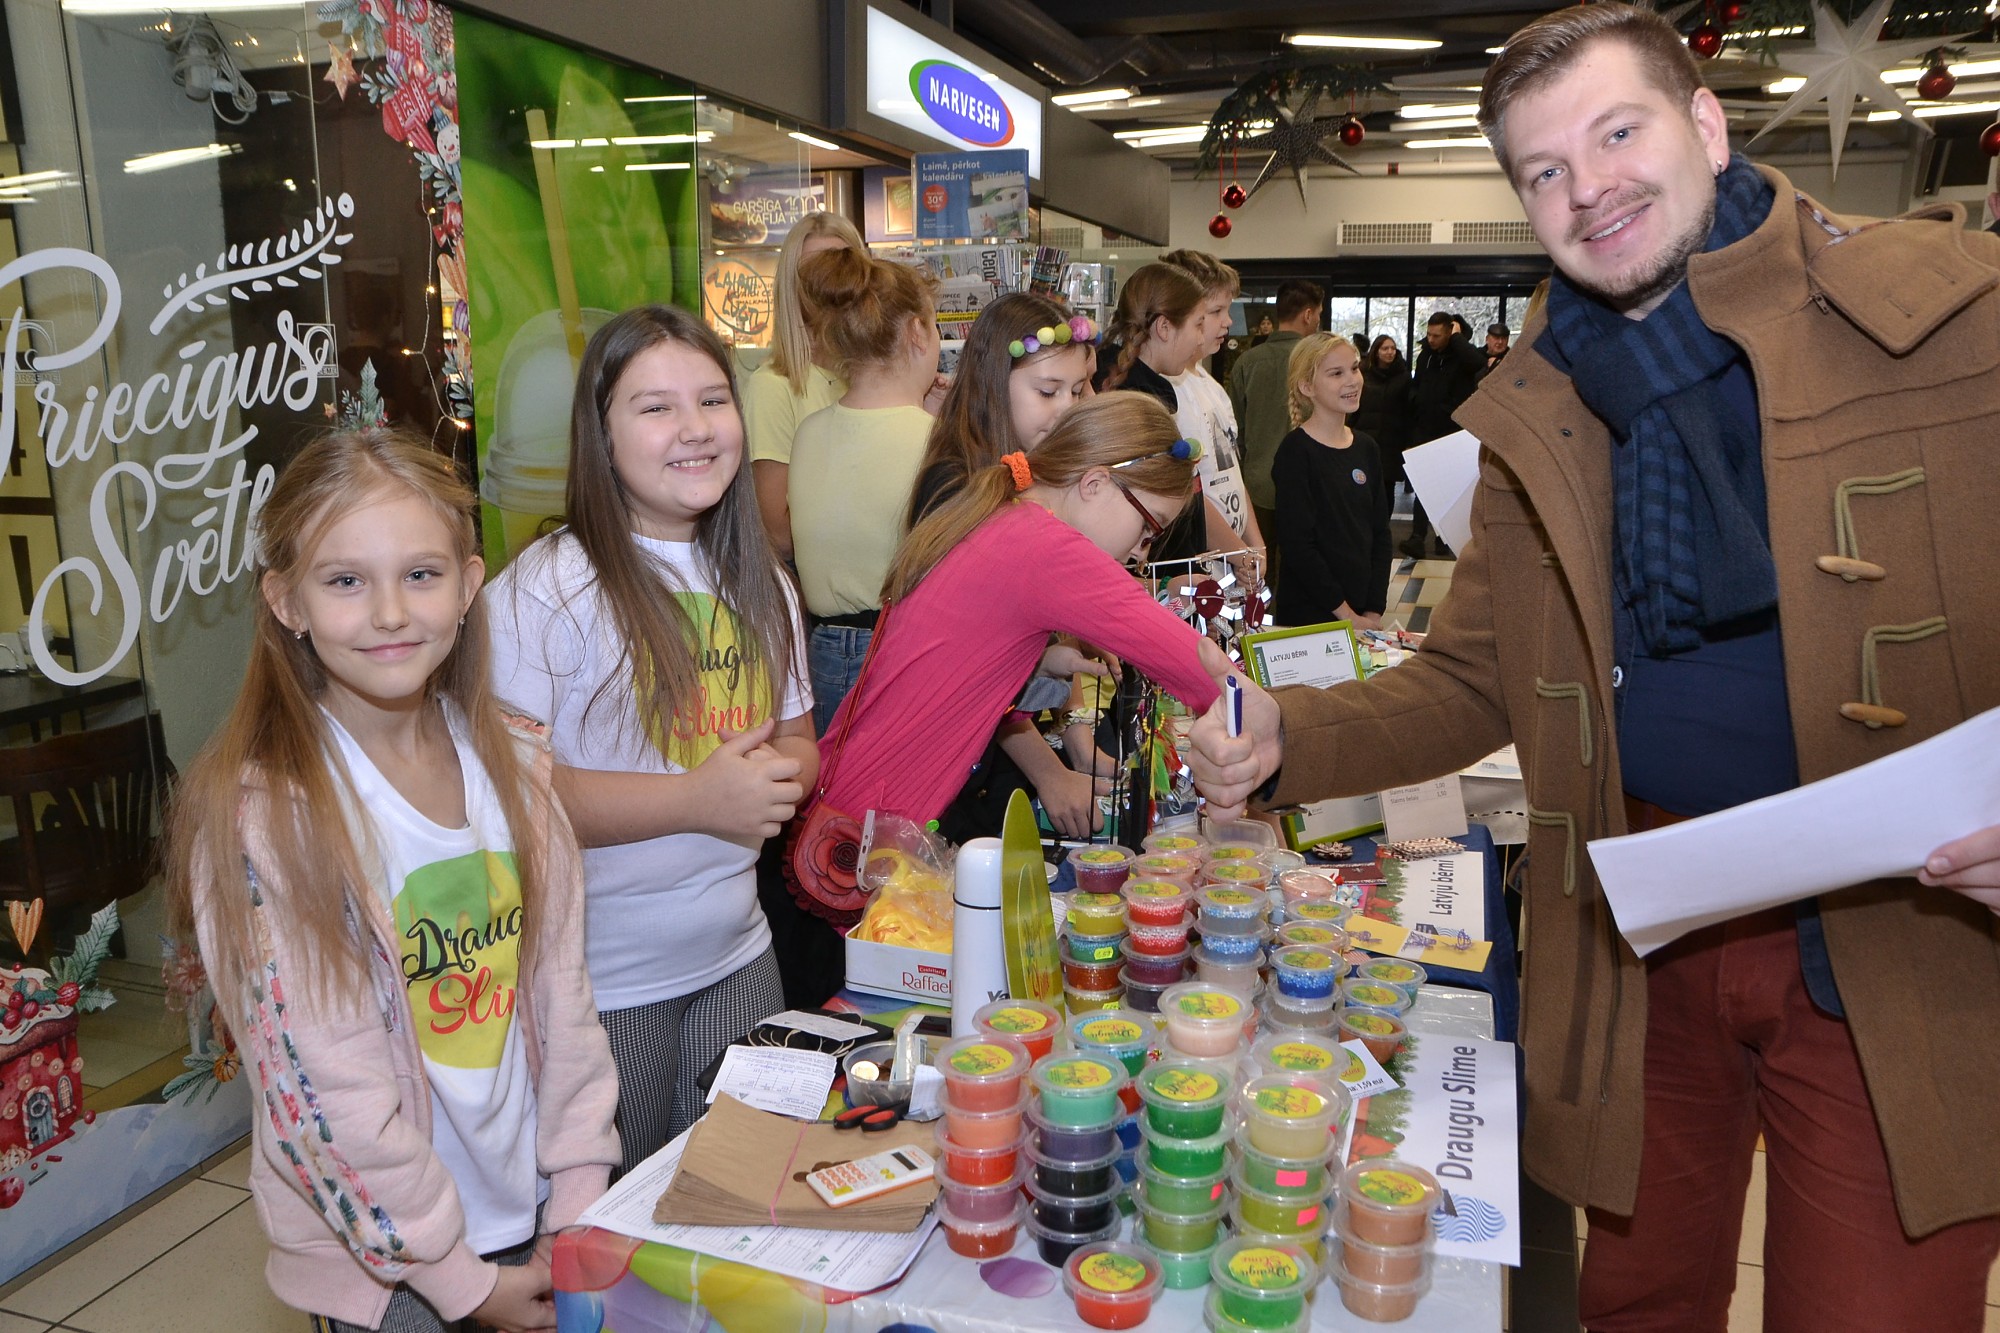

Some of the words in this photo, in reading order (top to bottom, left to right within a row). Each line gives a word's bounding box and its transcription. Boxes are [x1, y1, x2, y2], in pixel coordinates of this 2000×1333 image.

[930, 77, 1000, 132] NARVESEN
[922, 161, 950, 172] Laimē,
[952, 160, 981, 170] pērkot
[922, 172, 964, 182] kalendāru
[733, 196, 782, 214] GARŠĪGA
[747, 211, 786, 226] KAFIJA
[28, 458, 275, 686] Svētk
[1269, 653, 1291, 663] LATVJU
[1291, 649, 1309, 659] BĒRNI
[1428, 884, 1460, 915] Latvju
[401, 906, 523, 989] Draug
[902, 971, 952, 994] Raffael
[428, 966, 516, 1035] Sli
[1441, 1046, 1477, 1095] Slime
[1436, 1098, 1485, 1180] Draugu
